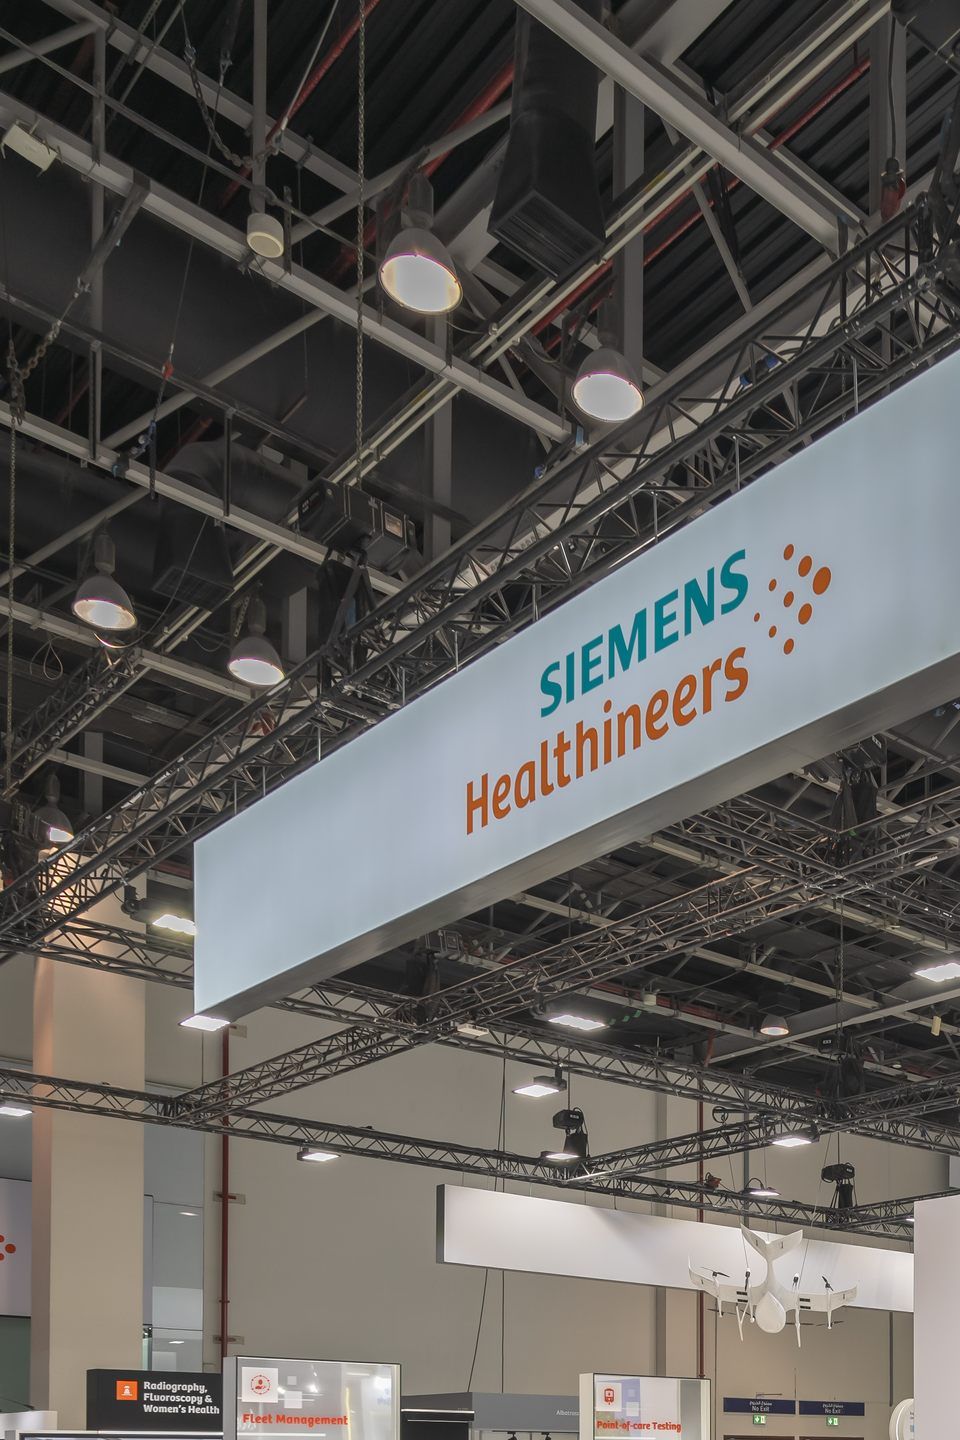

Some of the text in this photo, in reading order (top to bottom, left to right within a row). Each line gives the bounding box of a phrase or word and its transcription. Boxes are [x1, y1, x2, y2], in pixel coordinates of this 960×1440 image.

[540, 549, 748, 718] SIEMENS
[466, 647, 749, 835] Healthineers
[143, 1381, 208, 1394] Radiography,
[143, 1392, 213, 1405] Fluoroscopy &
[143, 1404, 220, 1414] Women's Health
[242, 1413, 348, 1428] Fleet Management
[596, 1420, 682, 1433] Point-of-care Testing
